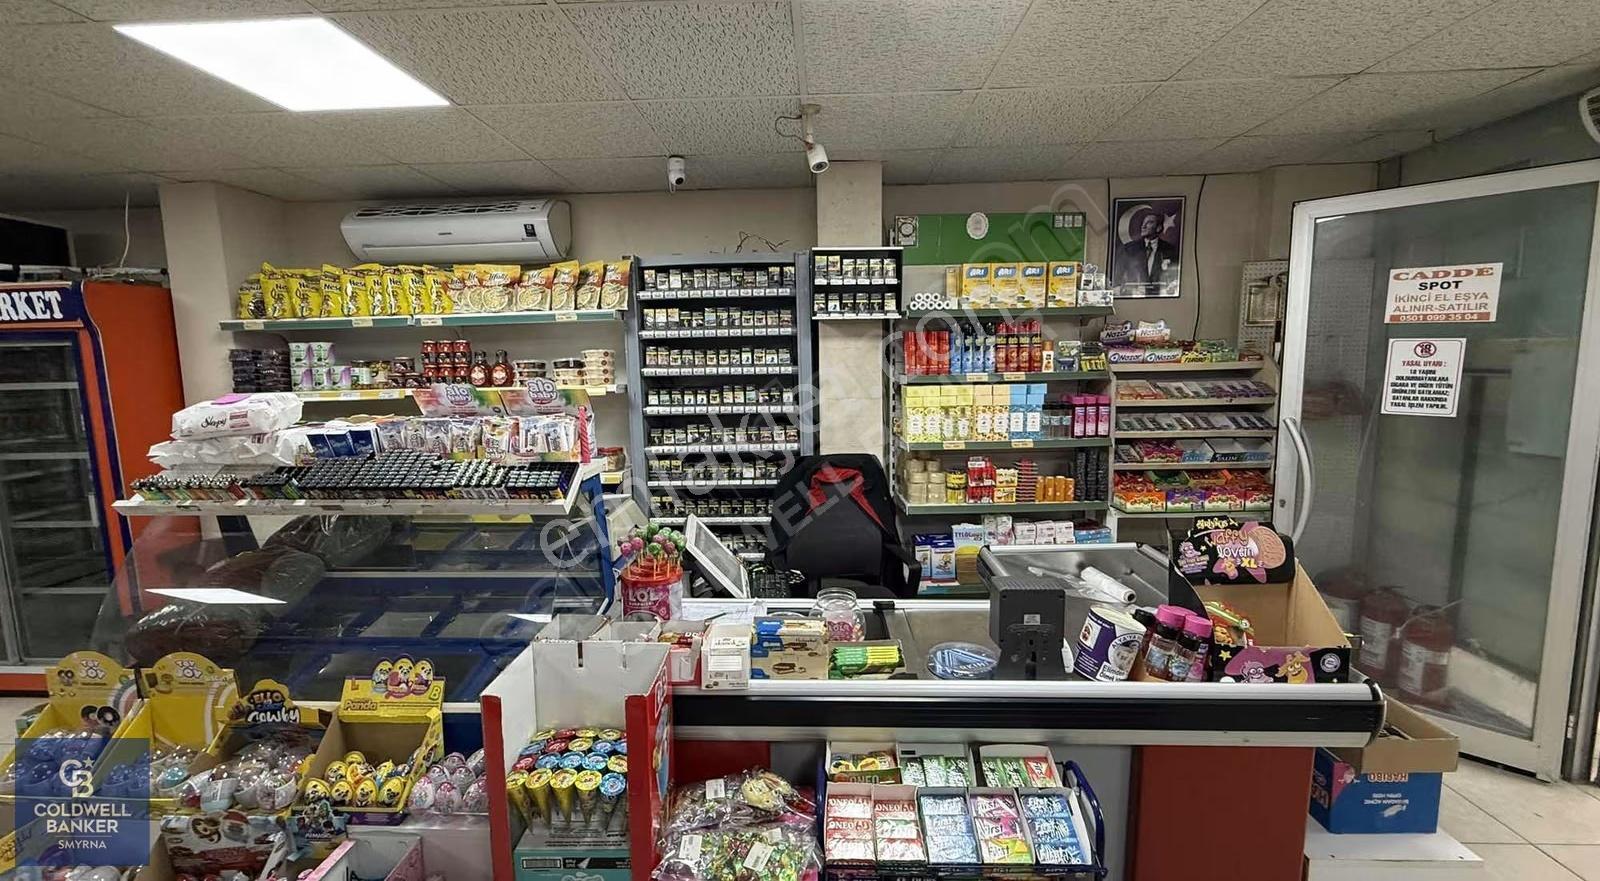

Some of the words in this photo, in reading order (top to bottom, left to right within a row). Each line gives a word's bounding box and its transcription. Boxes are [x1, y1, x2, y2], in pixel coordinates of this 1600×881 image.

[1393, 267, 1494, 280] CADDE
[1418, 280, 1463, 290] SPOT
[1394, 292, 1431, 302] İKİNCİ
[1393, 302, 1489, 312] ALINIR-SATILIR
[1118, 353, 1142, 362] Nazar
[1155, 352, 1180, 362] Nazar
[528, 380, 555, 393] alo
[529, 390, 558, 401] baby
[1240, 557, 1258, 568] XL
[344, 700, 378, 711] Panda
